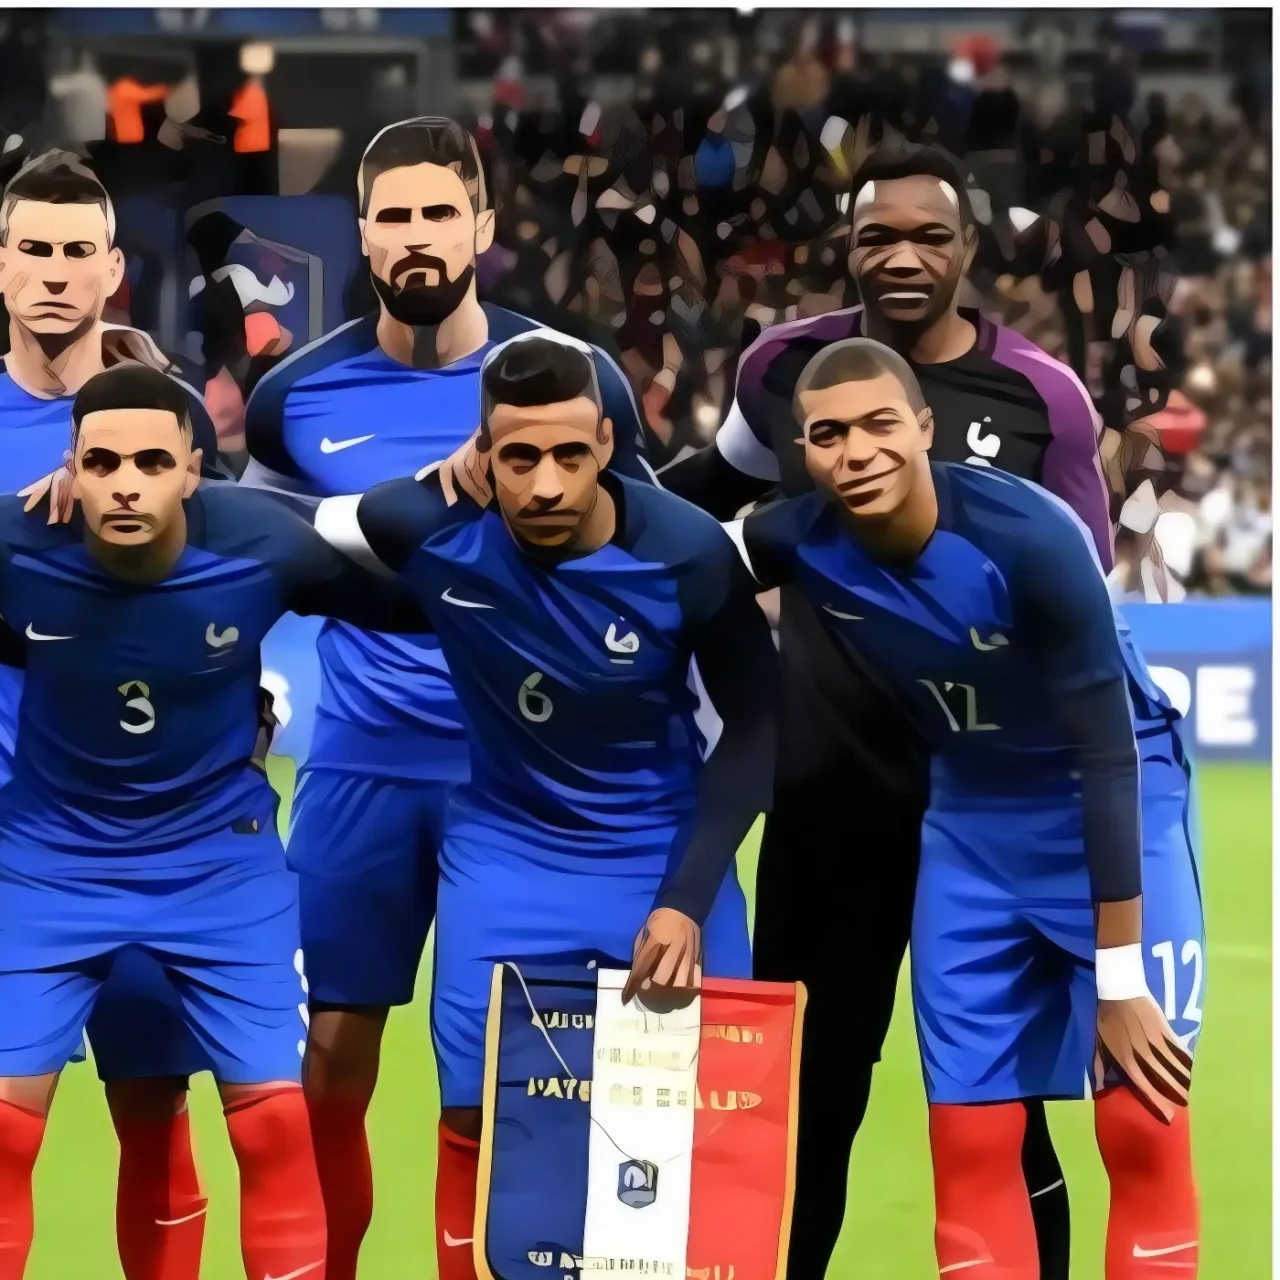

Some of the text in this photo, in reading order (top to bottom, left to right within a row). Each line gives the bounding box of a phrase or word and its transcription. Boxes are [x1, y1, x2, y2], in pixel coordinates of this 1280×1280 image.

[117, 680, 156, 734] 3
[517, 673, 554, 723] 6
[1151, 939, 1203, 1023] 12
